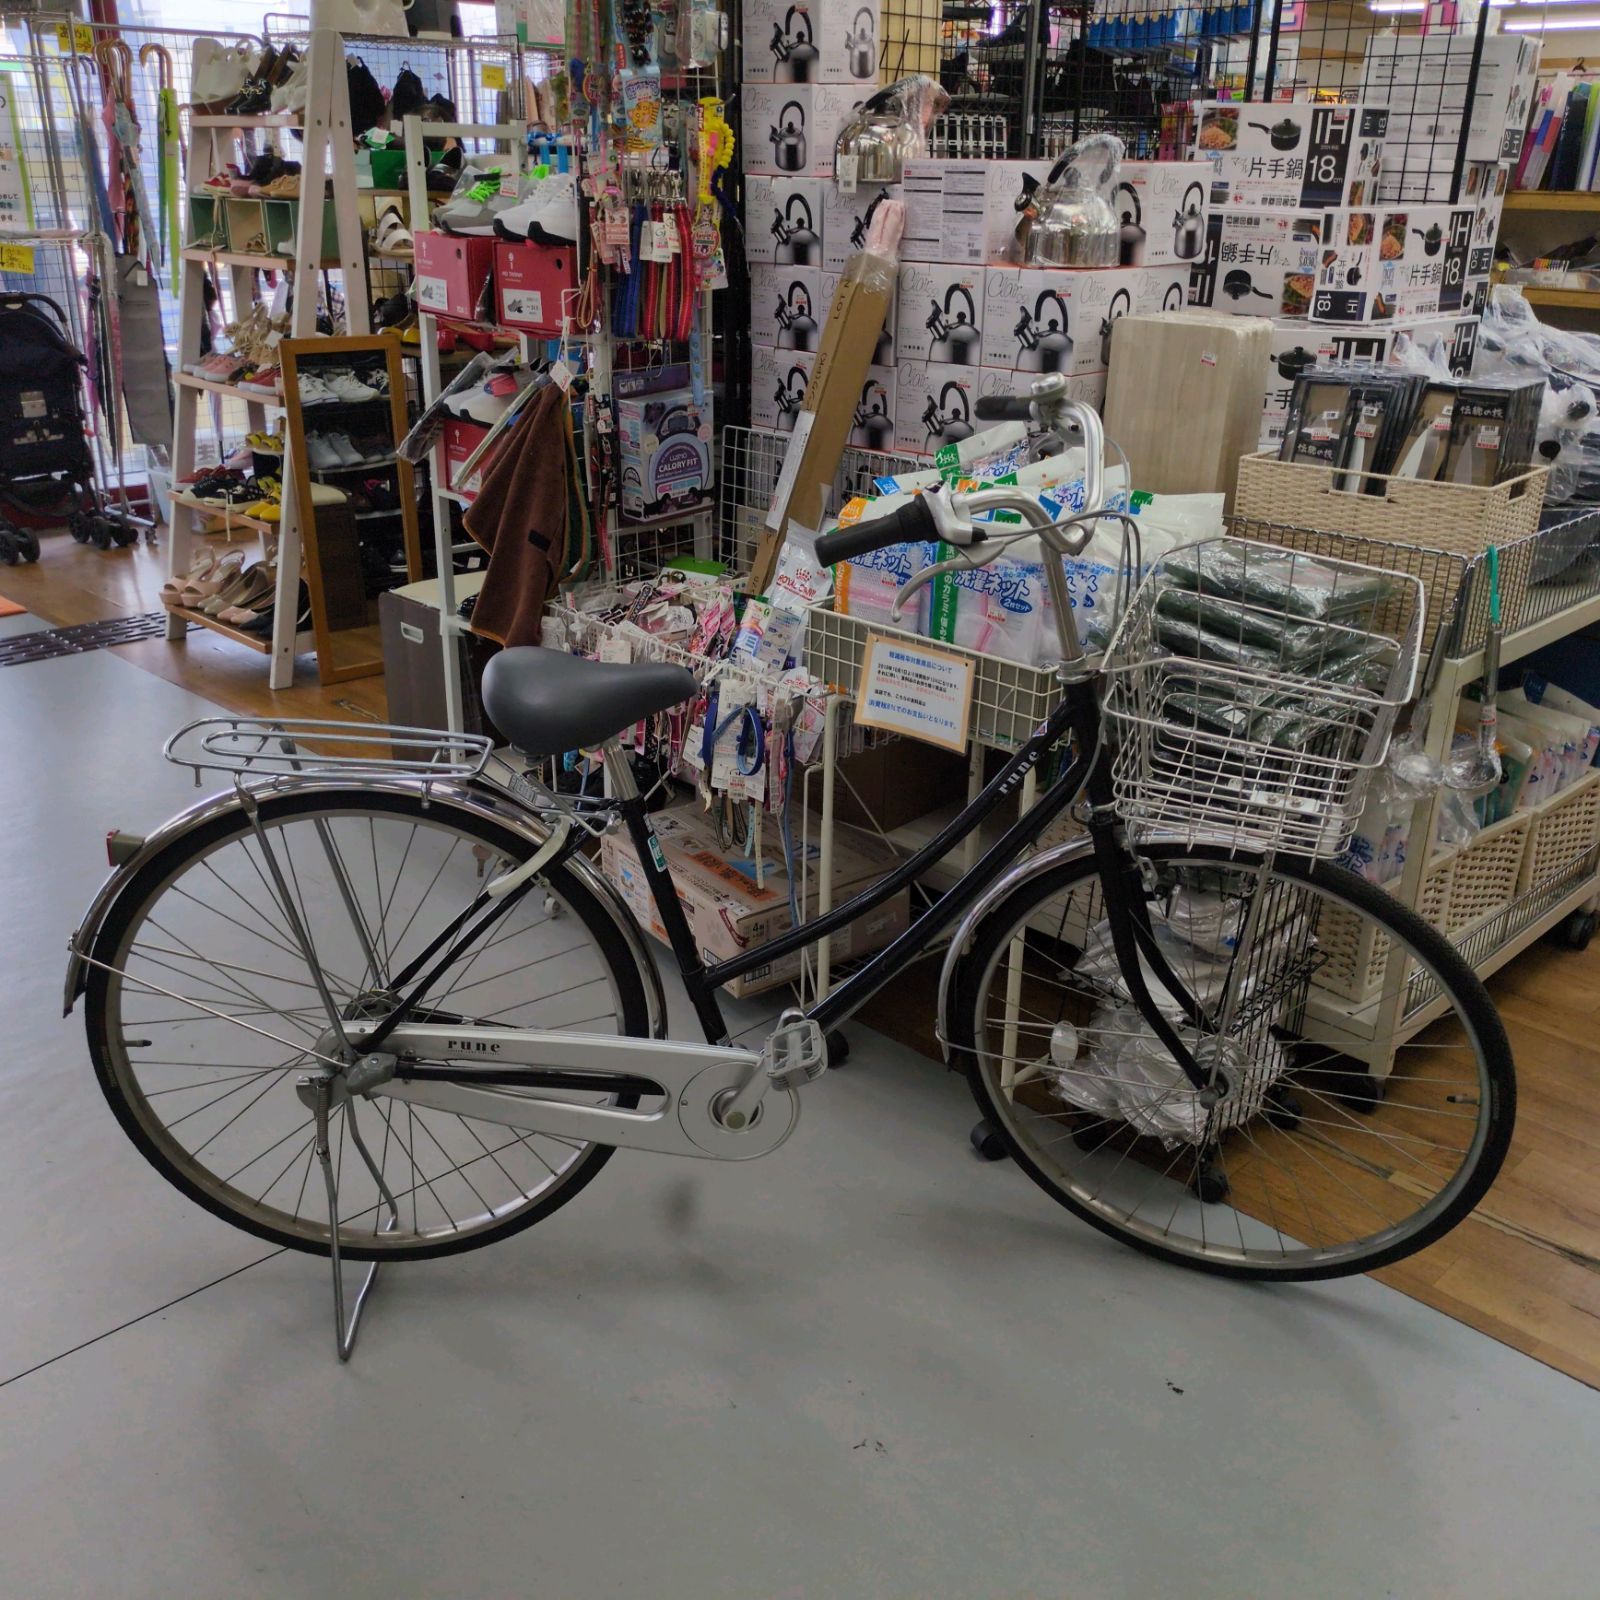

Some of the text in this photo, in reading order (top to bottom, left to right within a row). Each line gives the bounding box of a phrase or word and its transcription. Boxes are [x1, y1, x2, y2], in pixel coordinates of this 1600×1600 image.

[1315, 112, 1350, 144] IH
[1248, 156, 1304, 180] 片手鍋
[1309, 155, 1336, 183] 18
[1449, 214, 1472, 247] IH
[1221, 241, 1274, 266] 片手鍋
[1408, 263, 1442, 287] 片手鍋
[1445, 257, 1461, 285] 18
[1317, 293, 1332, 312] 18
[1346, 300, 1359, 314] IH
[1454, 325, 1476, 357] IH
[659, 457, 699, 473] CALORY FIT
[777, 574, 799, 590] ROYAL
[954, 569, 1030, 600] 洗濯ネット
[999, 751, 1038, 794] rune
[448, 1040, 501, 1053] rune
